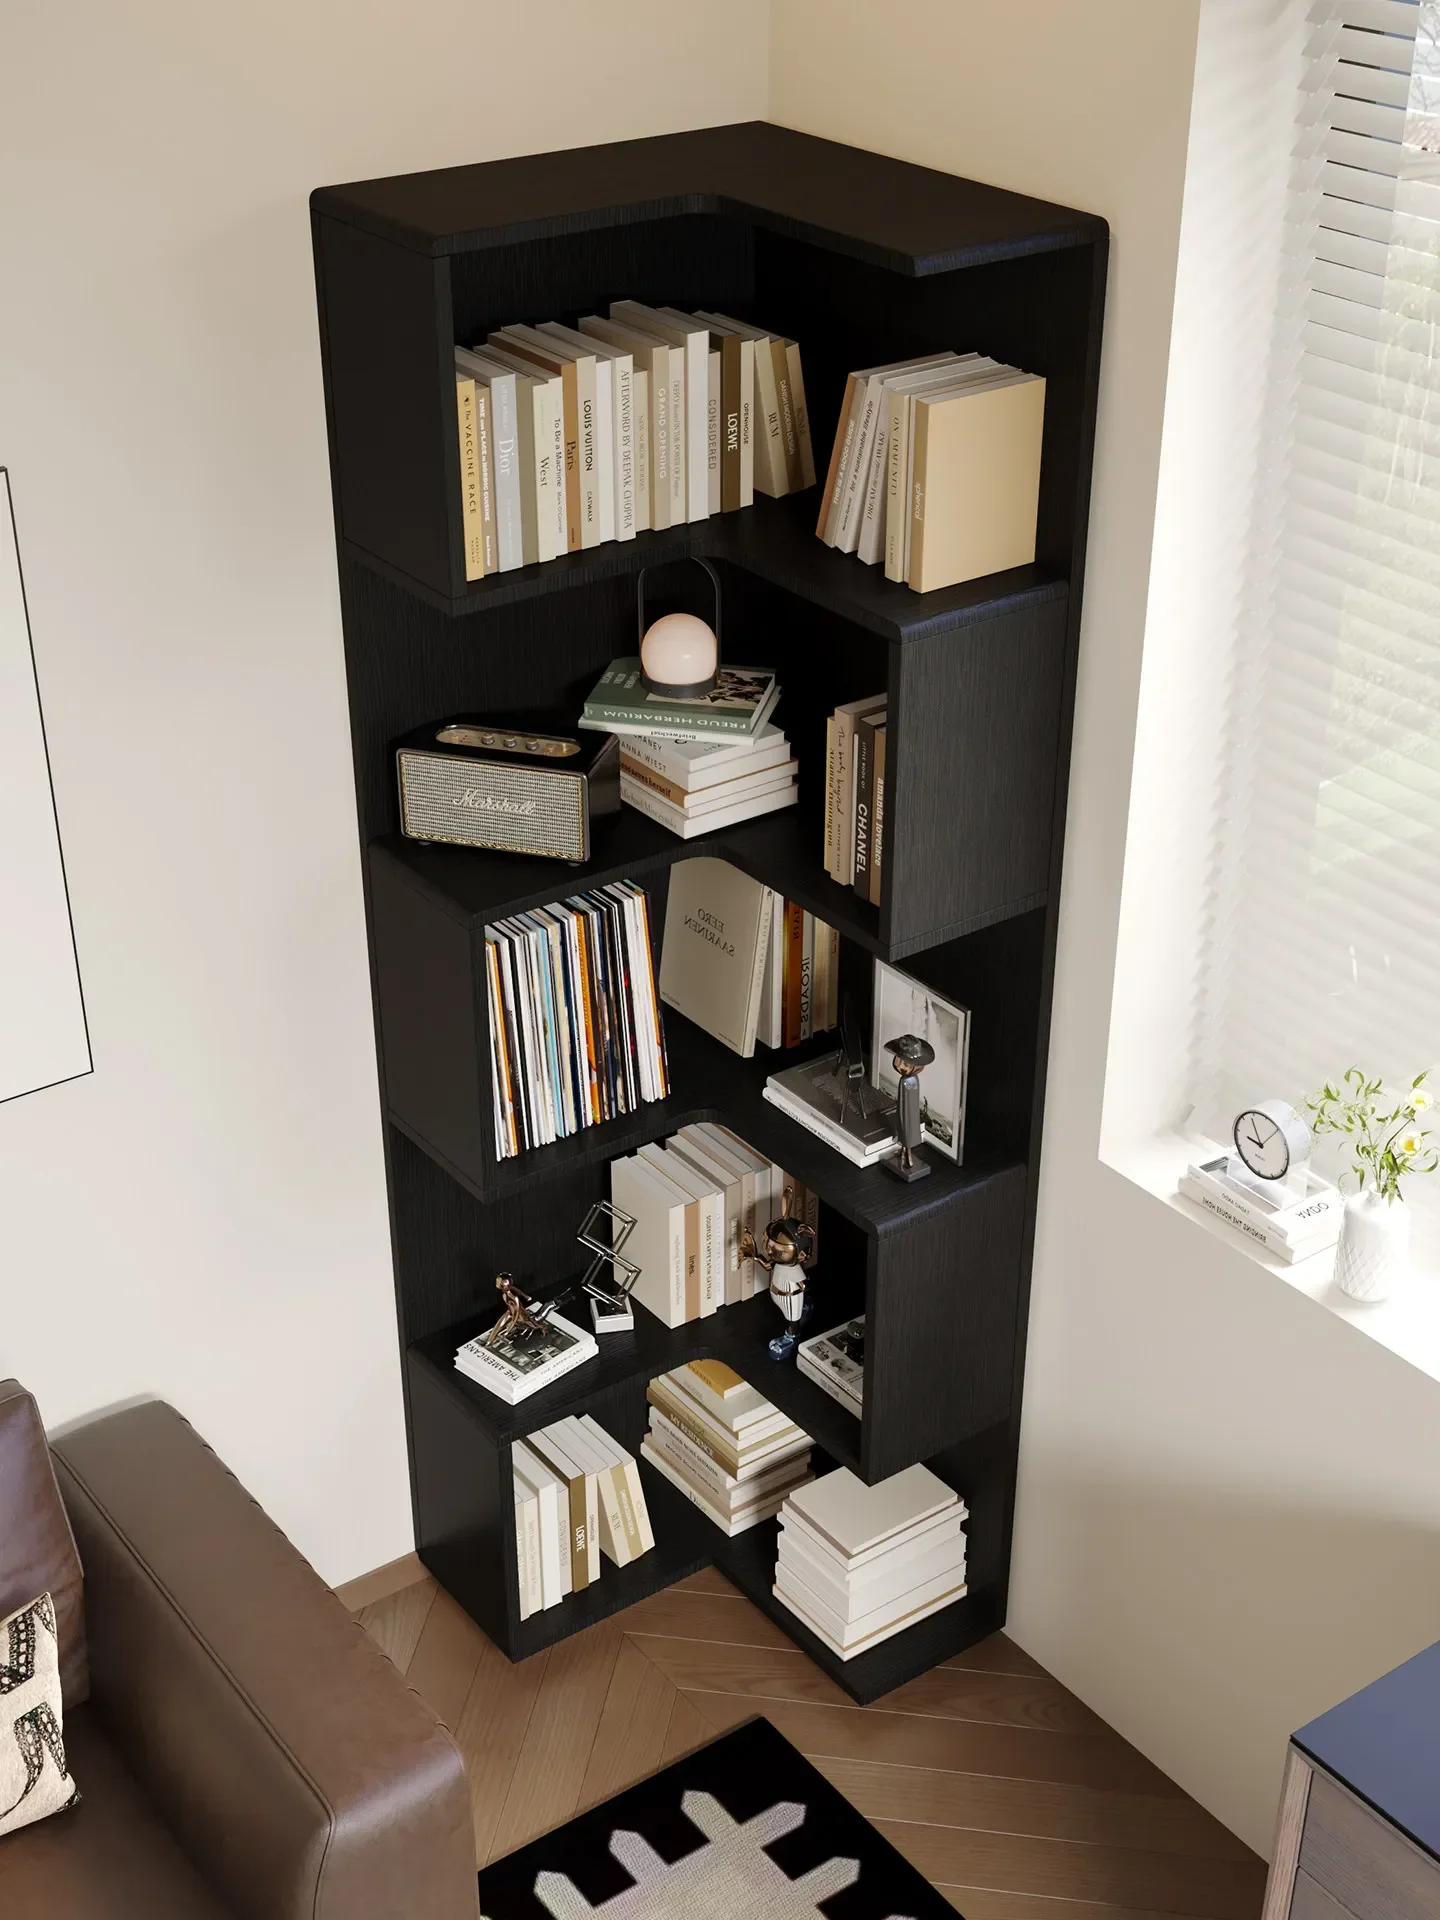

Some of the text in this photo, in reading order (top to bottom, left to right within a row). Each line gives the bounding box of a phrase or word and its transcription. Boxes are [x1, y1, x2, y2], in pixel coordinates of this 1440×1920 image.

[554, 419, 561, 429] To
[555, 430, 561, 442] Be
[583, 400, 593, 472] LOUIS VUITTON
[708, 399, 717, 470] CONSIDERED
[727, 413, 738, 452] LOEWE
[768, 411, 780, 438] RUM
[854, 431, 868, 474] sustainable
[863, 400, 873, 432] lifestyle
[465, 425, 475, 477] VACCINE
[500, 437, 514, 476] Dior
[566, 440, 577, 470] Paris
[620, 370, 633, 529] AFTERWORD BY DEEPAK CHOPRA
[540, 456, 550, 487] West
[467, 484, 477, 515] RACE
[603, 710, 747, 730] FREUD HERBARIUM
[645, 753, 667, 773] WIEST
[452, 788, 537, 815] Marshall
[856, 803, 868, 873] CHANEL
[874, 777, 884, 867] amanda lovelace
[463, 1343, 521, 1381] THE AMERICANS
[575, 1525, 585, 1553] LOEWE
